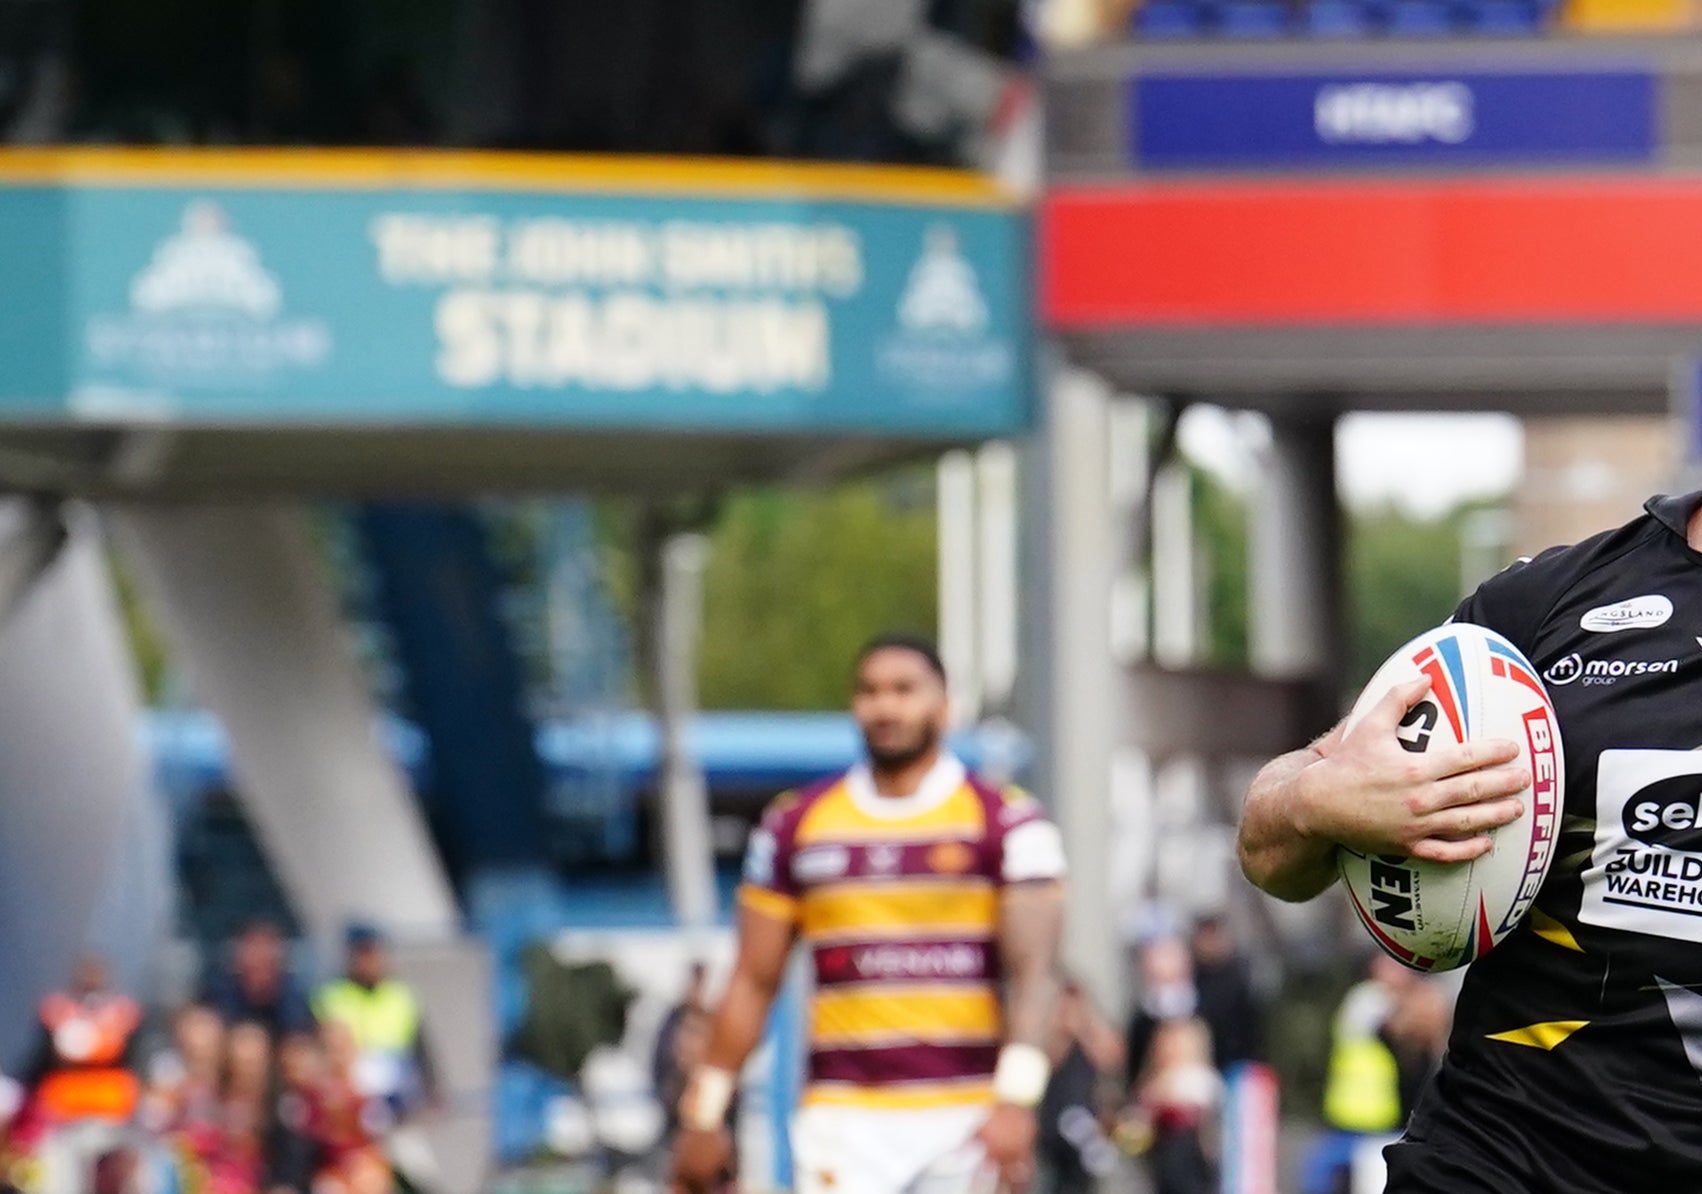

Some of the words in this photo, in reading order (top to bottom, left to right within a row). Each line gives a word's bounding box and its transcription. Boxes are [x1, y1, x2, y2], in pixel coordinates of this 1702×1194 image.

[372, 214, 494, 284] THE
[434, 290, 832, 391] STADIUM
[1582, 675, 1617, 687] group
[1585, 659, 1679, 676] morson
[1502, 717, 1557, 930] BETFRED
